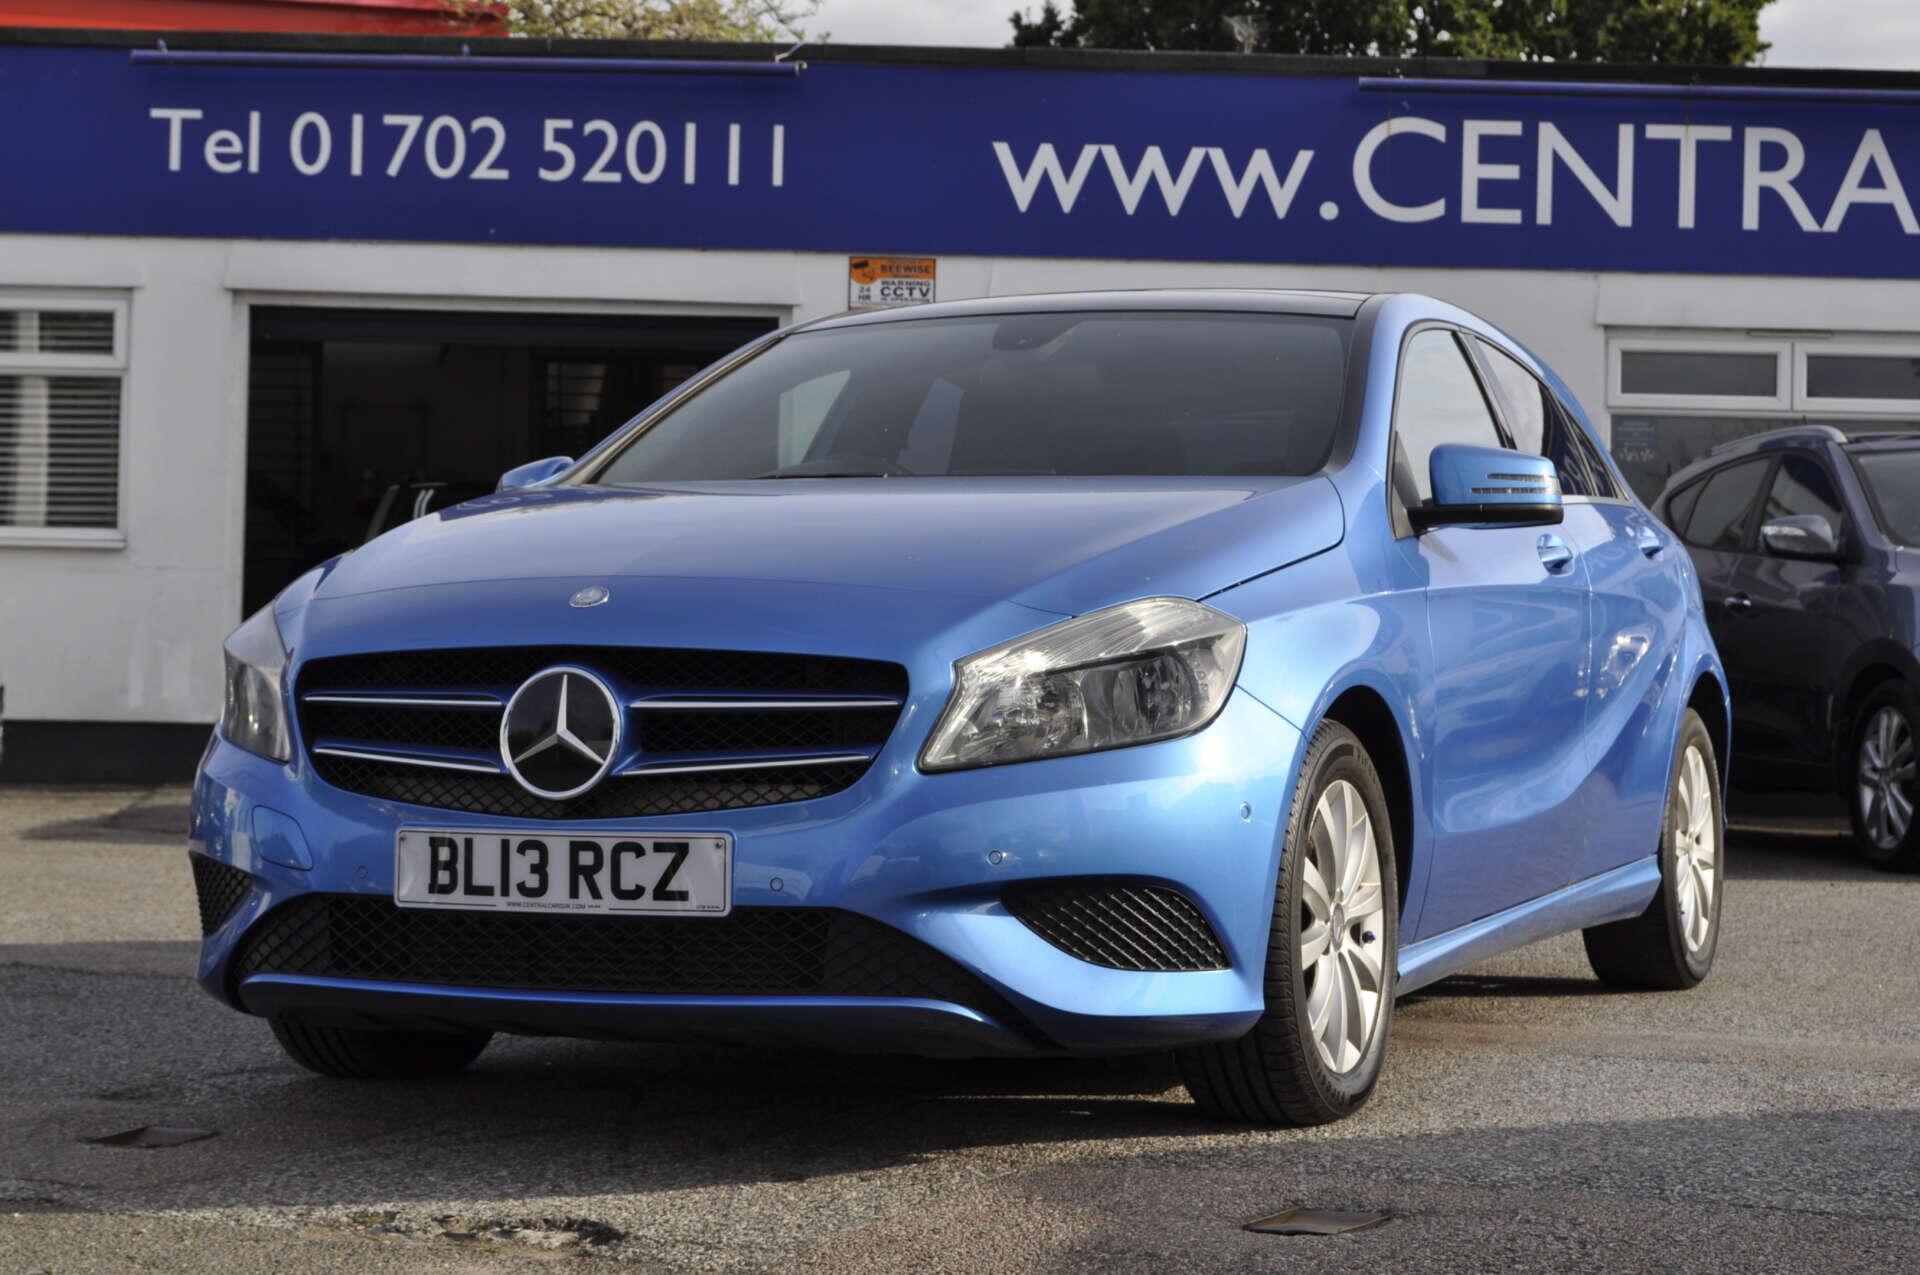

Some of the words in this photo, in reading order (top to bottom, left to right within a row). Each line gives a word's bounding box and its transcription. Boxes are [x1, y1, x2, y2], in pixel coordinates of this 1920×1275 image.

[150, 108, 261, 174] Tel
[290, 112, 509, 180] 01702
[539, 119, 784, 187] 520111
[993, 115, 1920, 235] www.CENTRA
[880, 286, 930, 298] CCTV
[428, 836, 549, 900] BL13
[568, 840, 691, 902] RCZ
